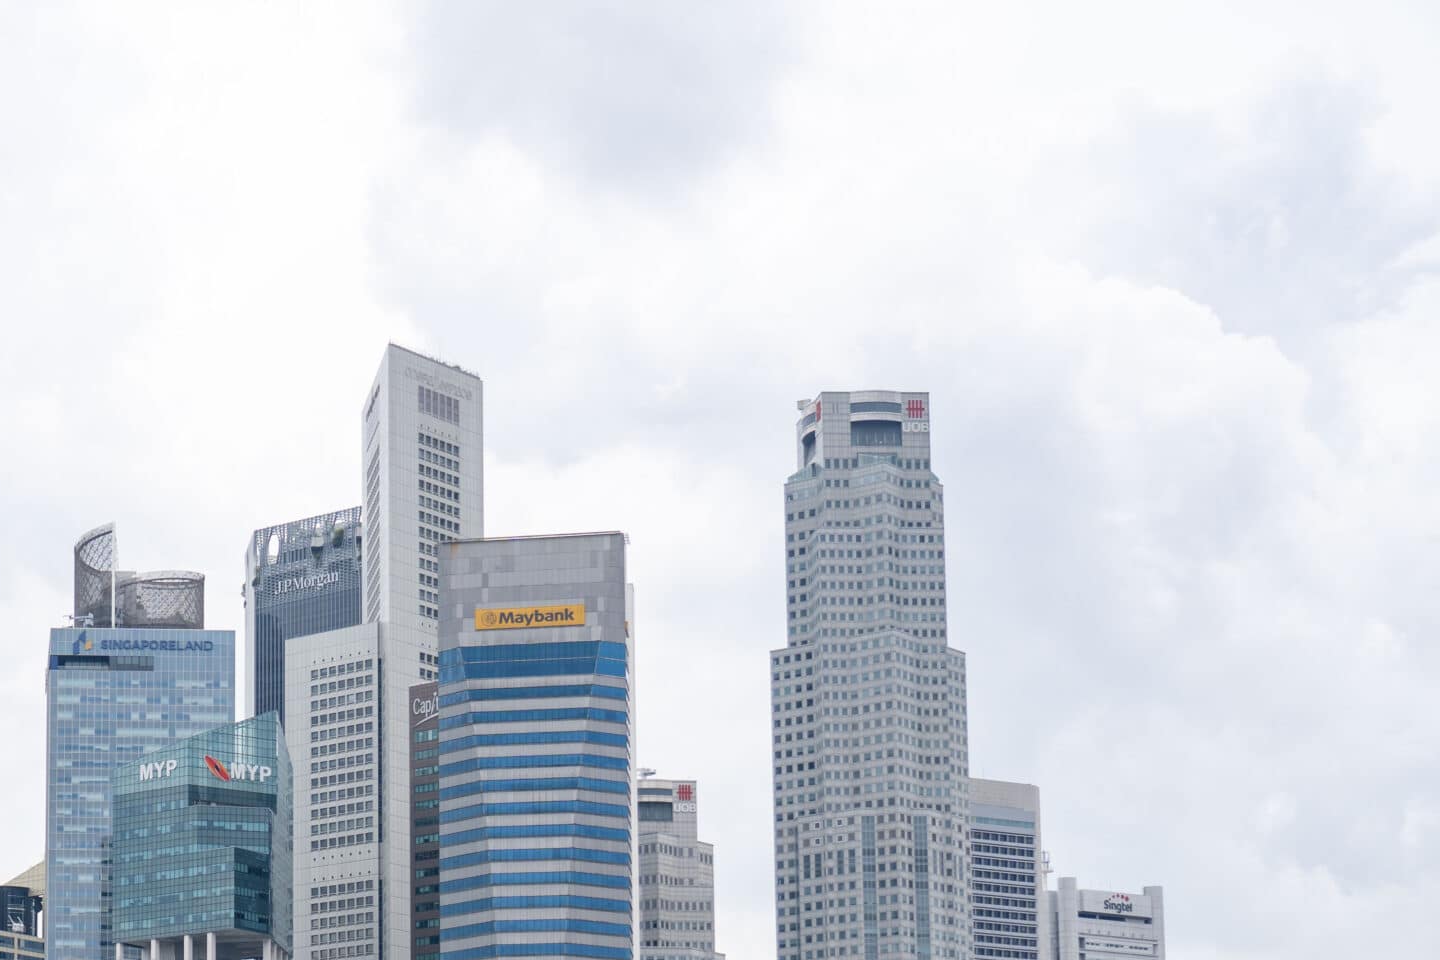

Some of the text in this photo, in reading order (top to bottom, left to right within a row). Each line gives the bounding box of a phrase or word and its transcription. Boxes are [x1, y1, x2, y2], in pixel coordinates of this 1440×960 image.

[903, 422, 928, 432] UOB
[274, 572, 338, 595] J.P.Morgan
[498, 608, 575, 627] Maybank
[100, 639, 213, 652] SINGAPORELAND
[140, 760, 177, 781] MYP
[231, 762, 272, 782] MYP
[673, 803, 697, 813] UOB
[1103, 899, 1133, 914] Singtel
